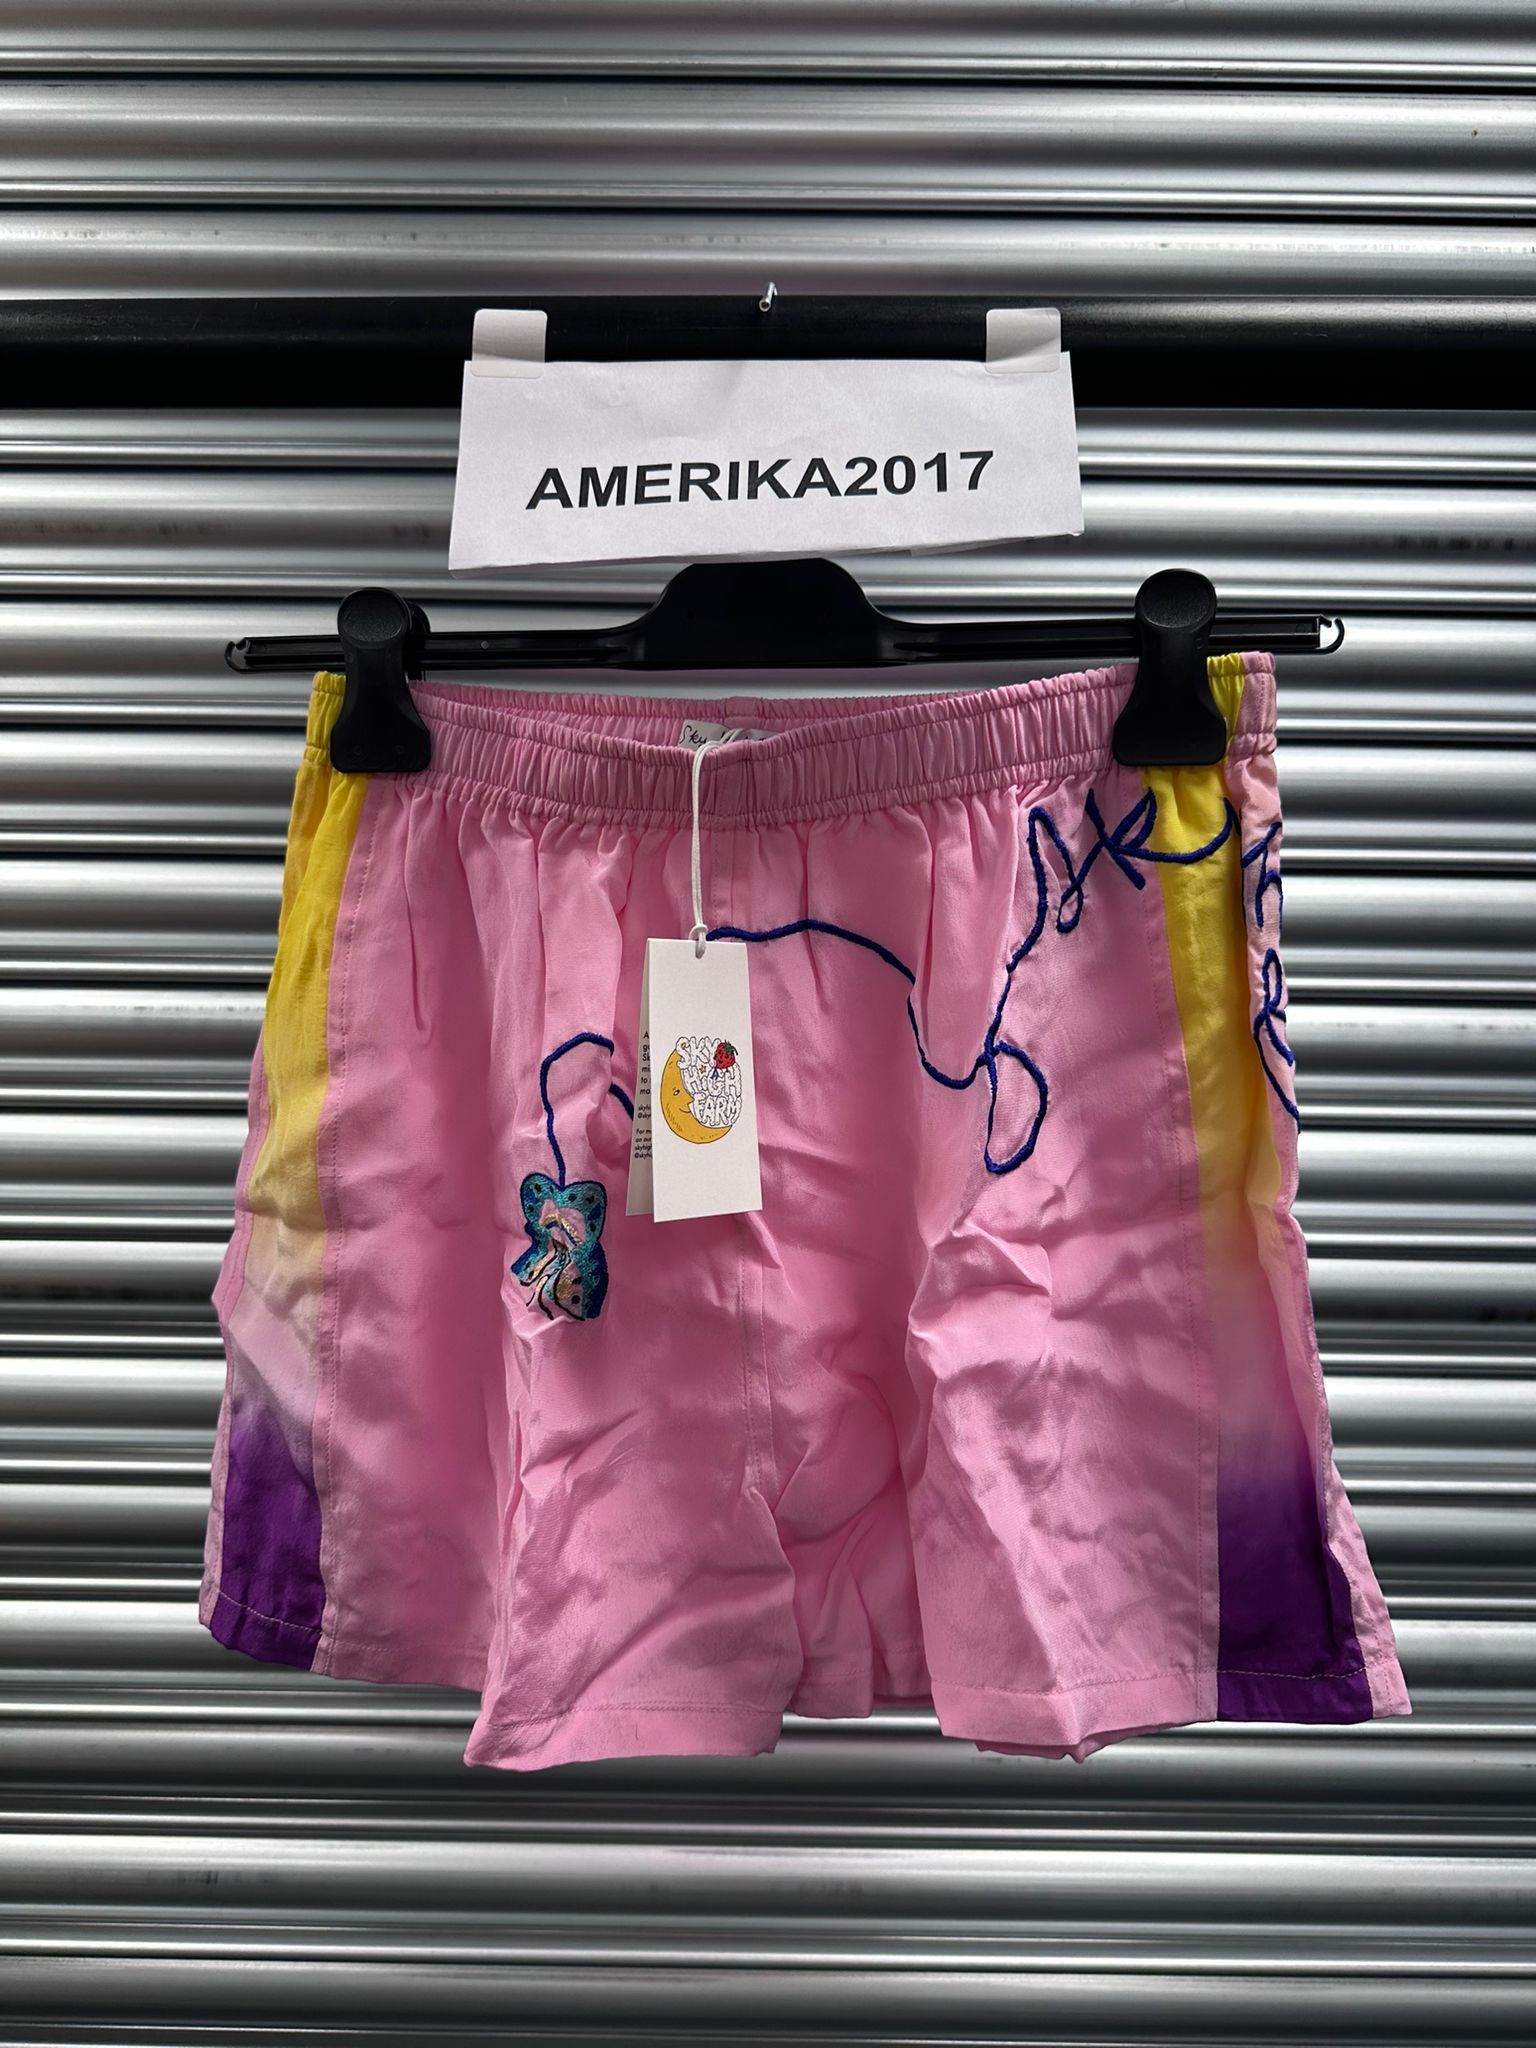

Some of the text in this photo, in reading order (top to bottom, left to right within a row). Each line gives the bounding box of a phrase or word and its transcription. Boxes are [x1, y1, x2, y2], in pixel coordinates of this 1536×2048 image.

[525, 451, 994, 510] AMERIKA2017
[675, 1036, 722, 1070] SKY
[691, 1091, 742, 1127] FARM
